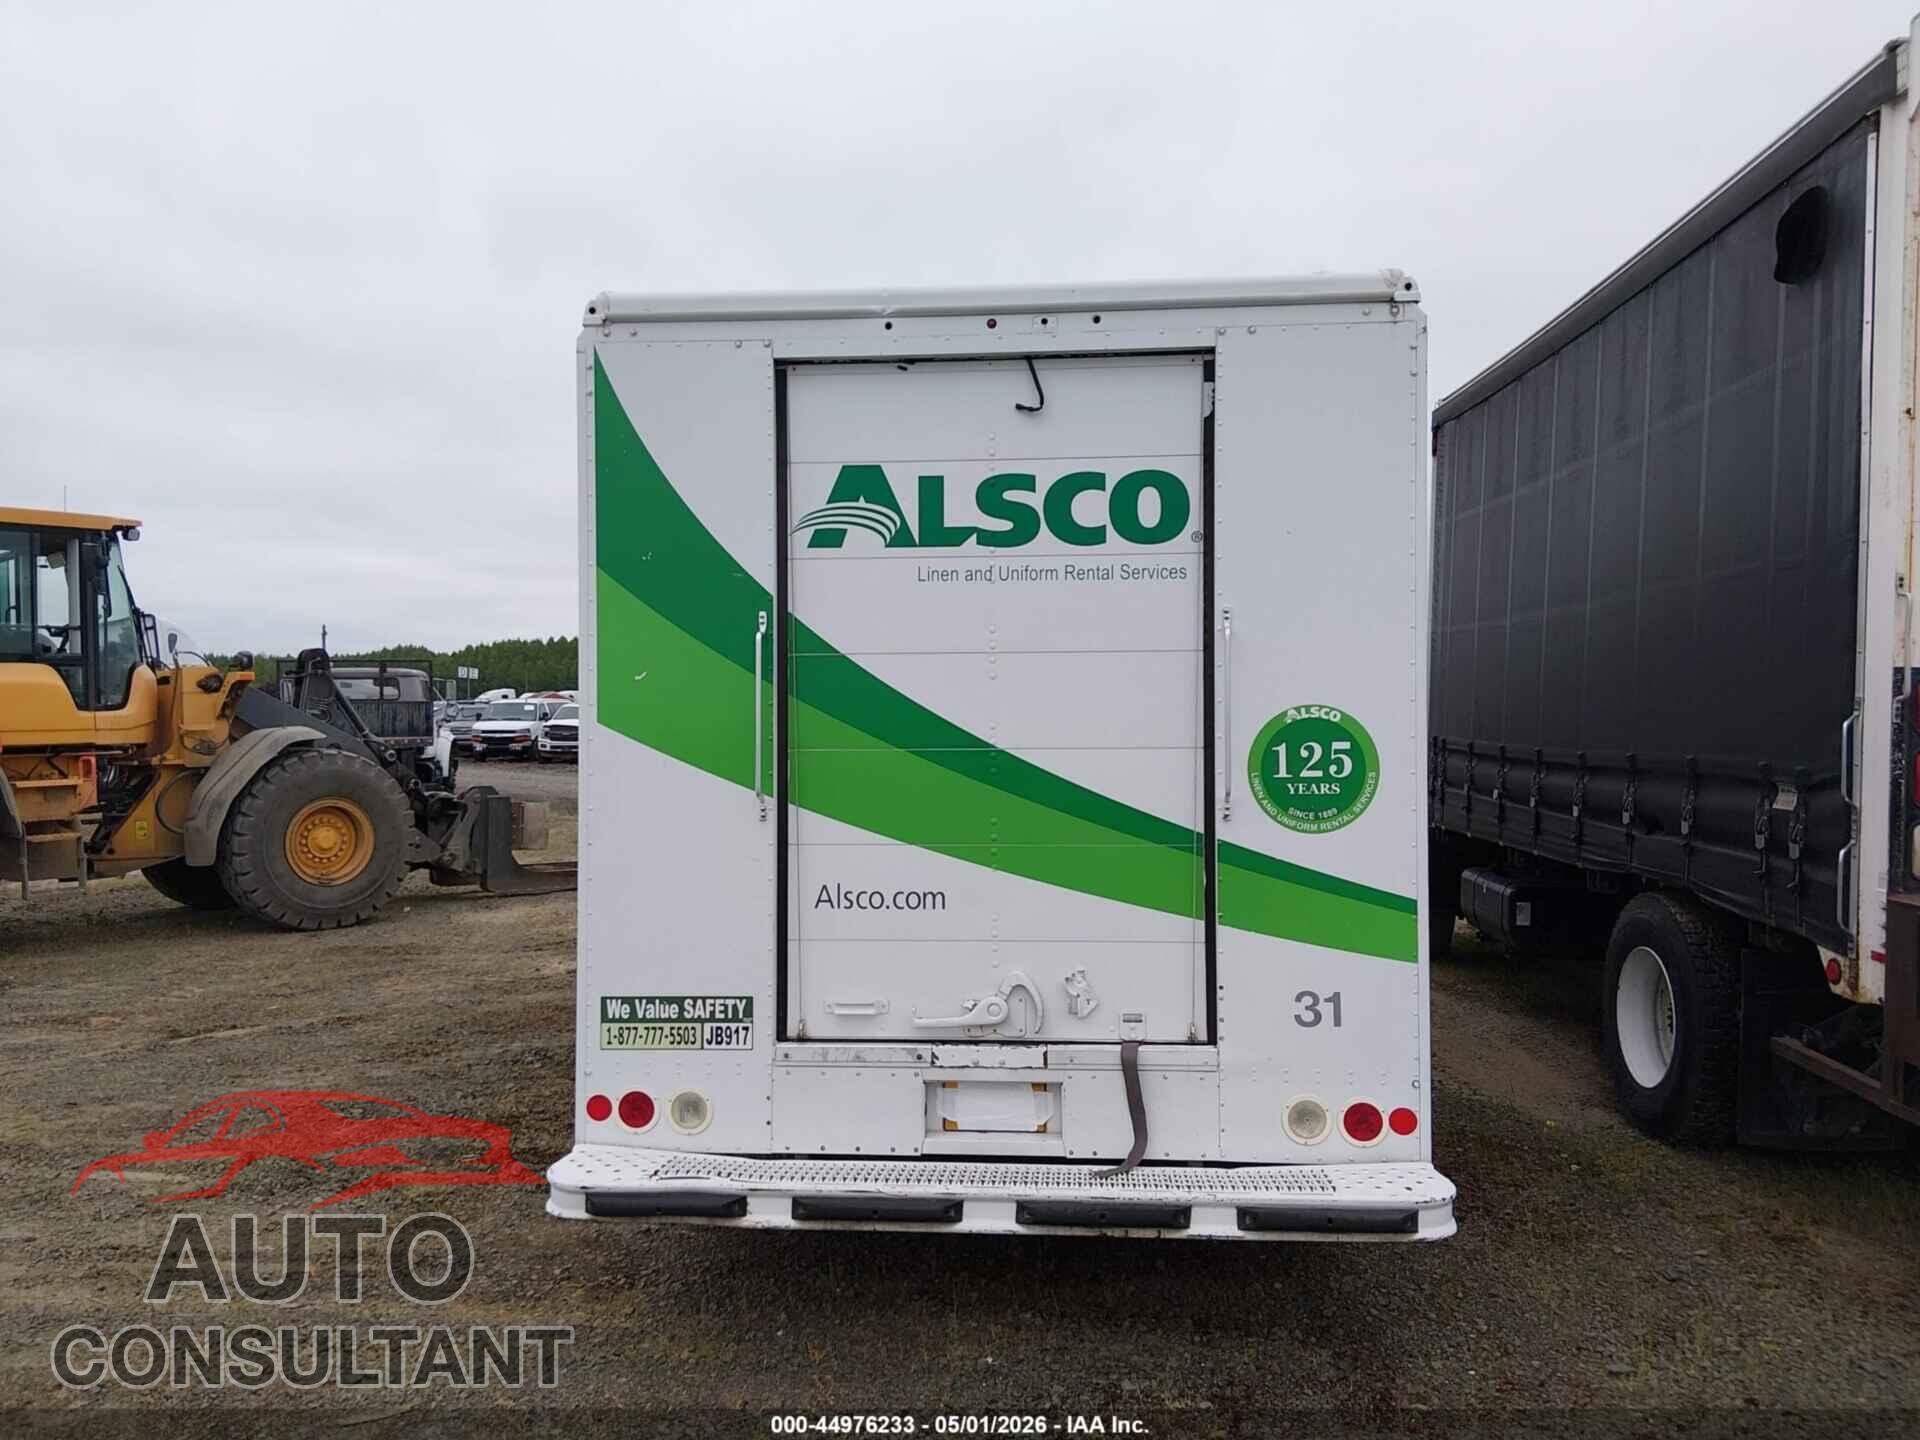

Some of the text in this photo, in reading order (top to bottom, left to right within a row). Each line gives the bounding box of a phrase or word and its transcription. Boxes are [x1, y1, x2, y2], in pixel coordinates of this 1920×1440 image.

[792, 465, 1191, 548] ALSCO
[917, 563, 1188, 583] Linen and Uniform Rental Services
[1285, 706, 1341, 724] ALSCO
[1271, 741, 1353, 778] 125
[1286, 783, 1341, 794] YEARS
[1251, 771, 1377, 831] LINEN AND UNIFORM RENTAL SERVICES
[1288, 807, 1315, 819] SINCE
[814, 882, 946, 910] Alsco.com
[606, 998, 747, 1019] We Value SAFETY
[1294, 990, 1342, 1028] 31
[606, 1026, 697, 1045] 1-877-777-5503
[705, 1025, 750, 1045] JB917
